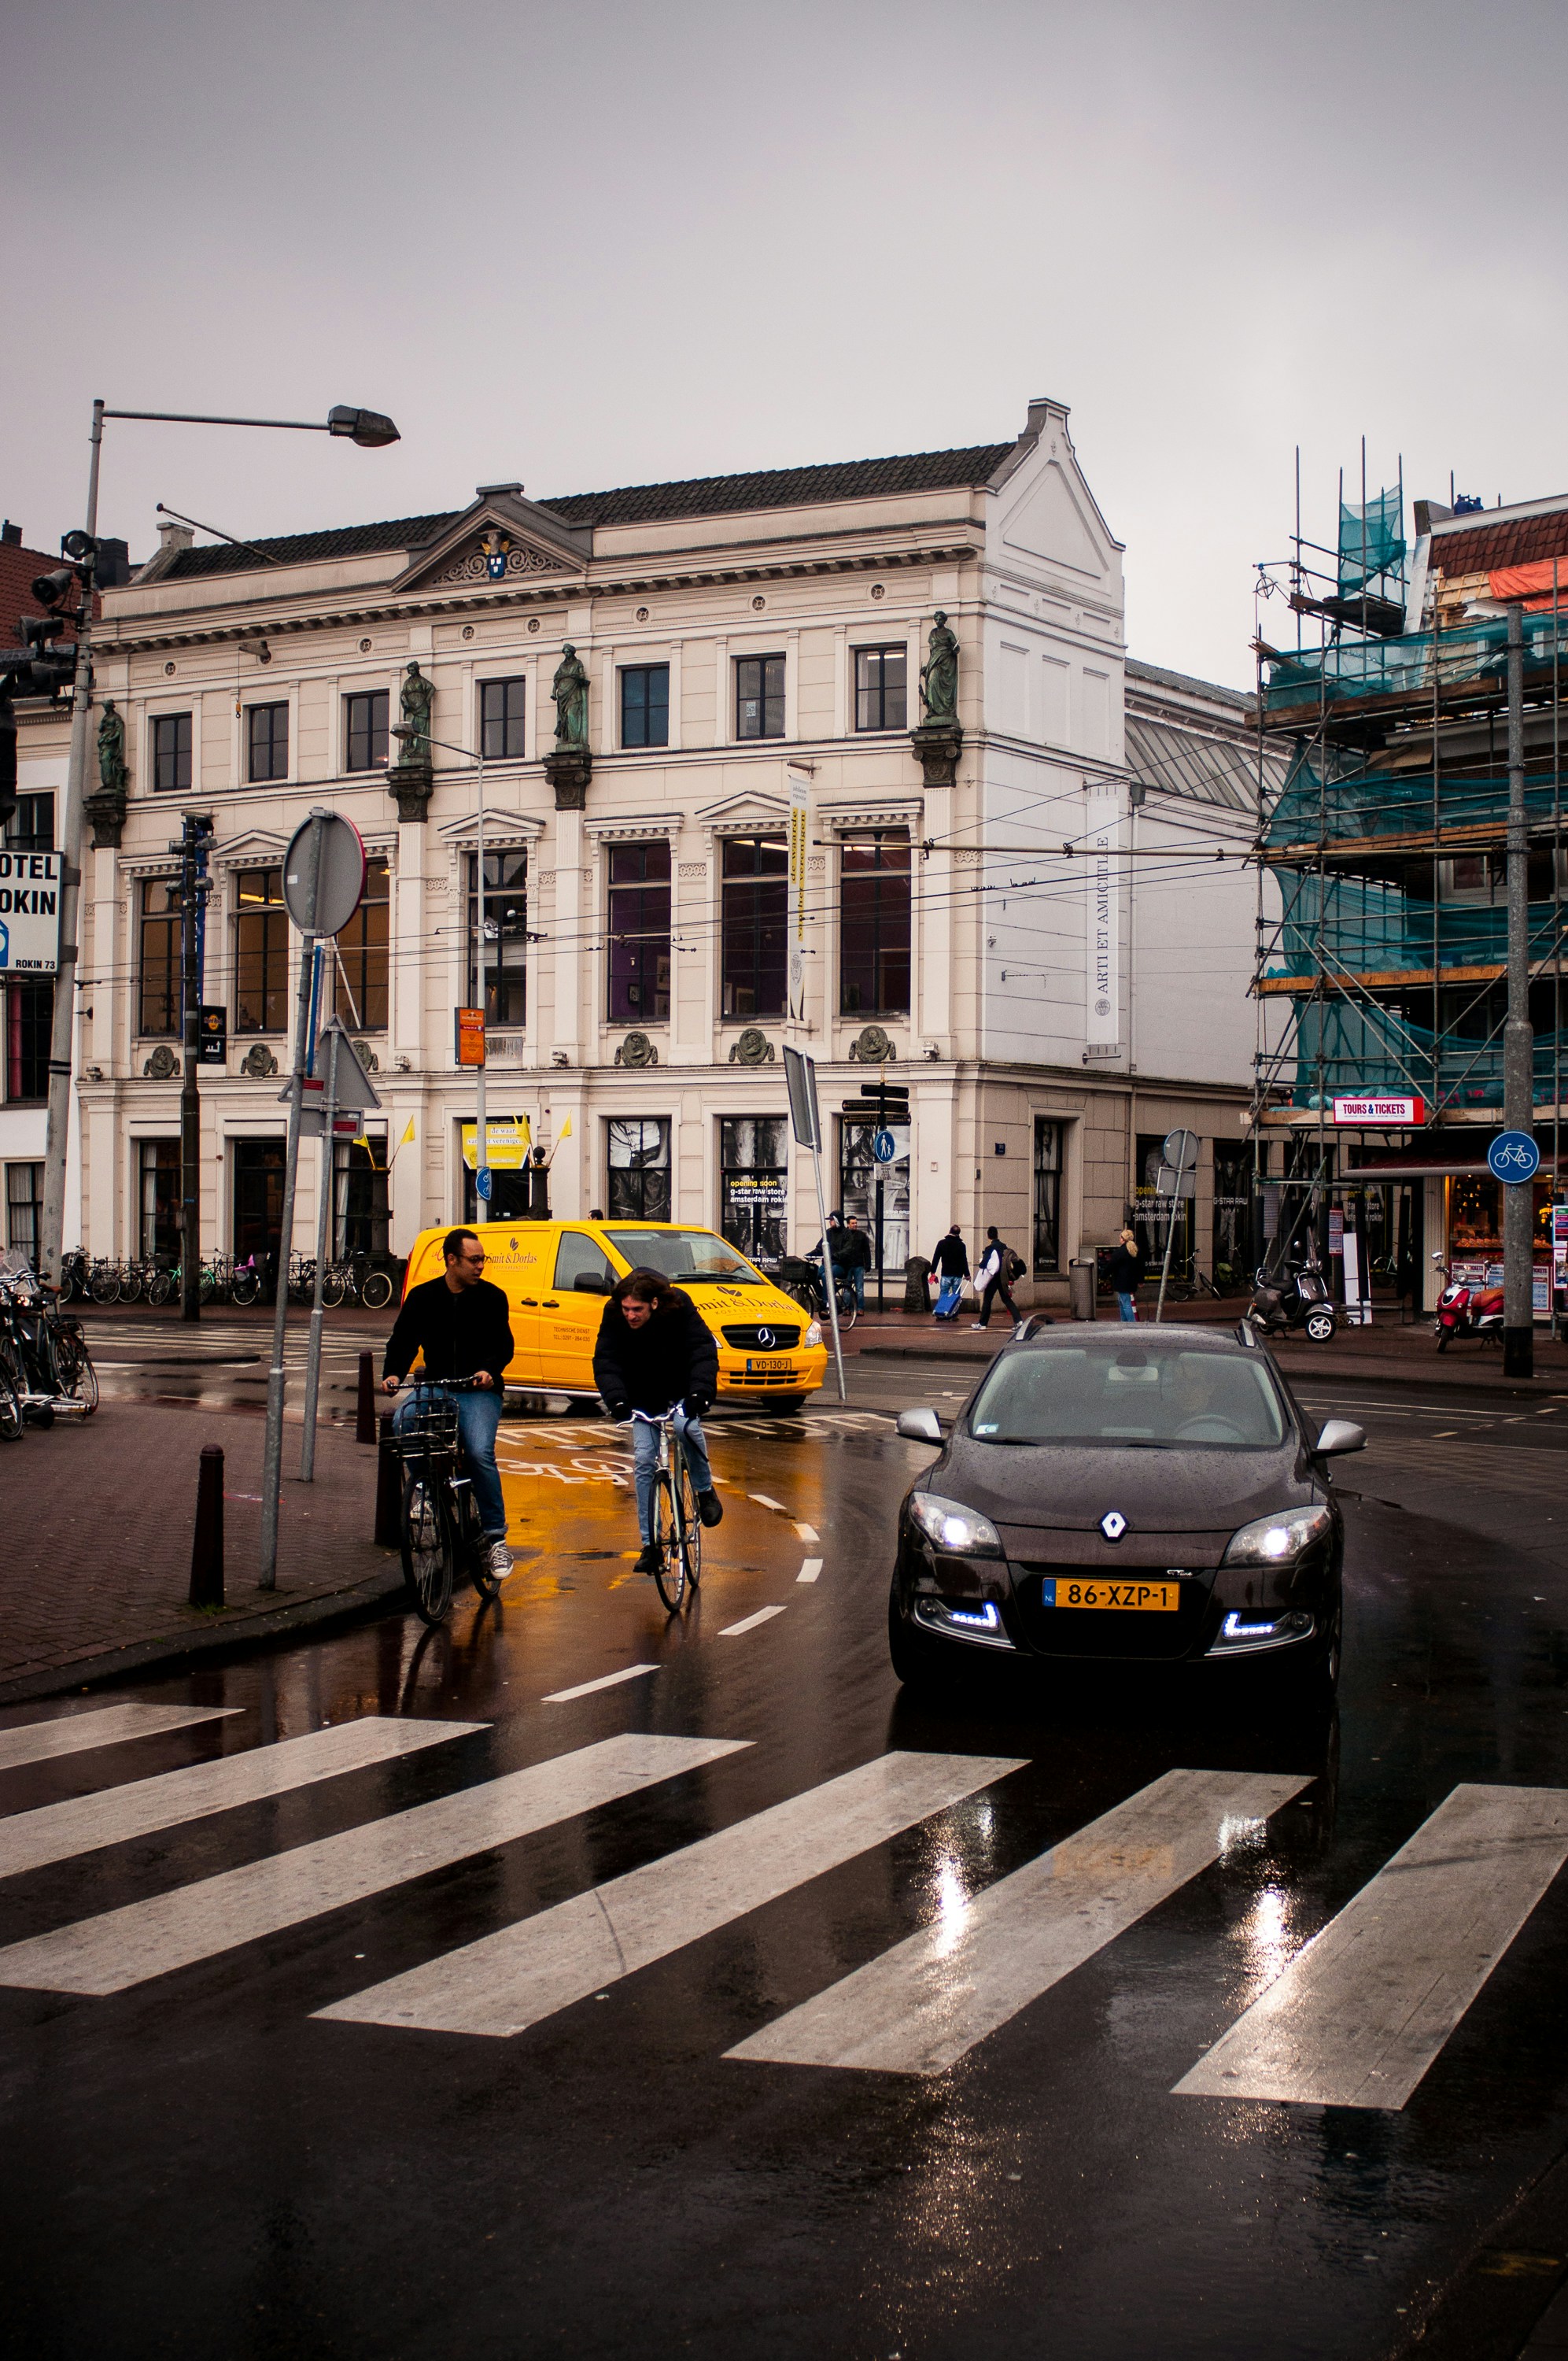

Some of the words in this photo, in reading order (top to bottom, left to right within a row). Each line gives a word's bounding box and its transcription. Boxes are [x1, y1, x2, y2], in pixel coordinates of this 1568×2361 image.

[791, 865, 796, 881] de
[1097, 929, 1108, 950] ET
[16, 959, 42, 969] ROKIN
[45, 961, 55, 969] 73
[1097, 956, 1108, 994] ARTI
[1343, 1104, 1367, 1114] TOURS
[1368, 1104, 1374, 1114] &
[1374, 1104, 1405, 1114] TICKETS
[1136, 1187, 1157, 1195] openin
[1136, 1199, 1153, 1209] g-star
[1169, 1199, 1184, 1208] stre
[1135, 1212, 1170, 1221] amsterdam
[488, 1253, 504, 1264] Smit
[505, 1254, 512, 1264] &
[512, 1252, 537, 1264] Dorlas
[697, 1299, 731, 1312] mit
[730, 1298, 748, 1307] &
[744, 1298, 799, 1313] Dorlas
[1068, 1584, 1166, 1607] 86-XZP-1
